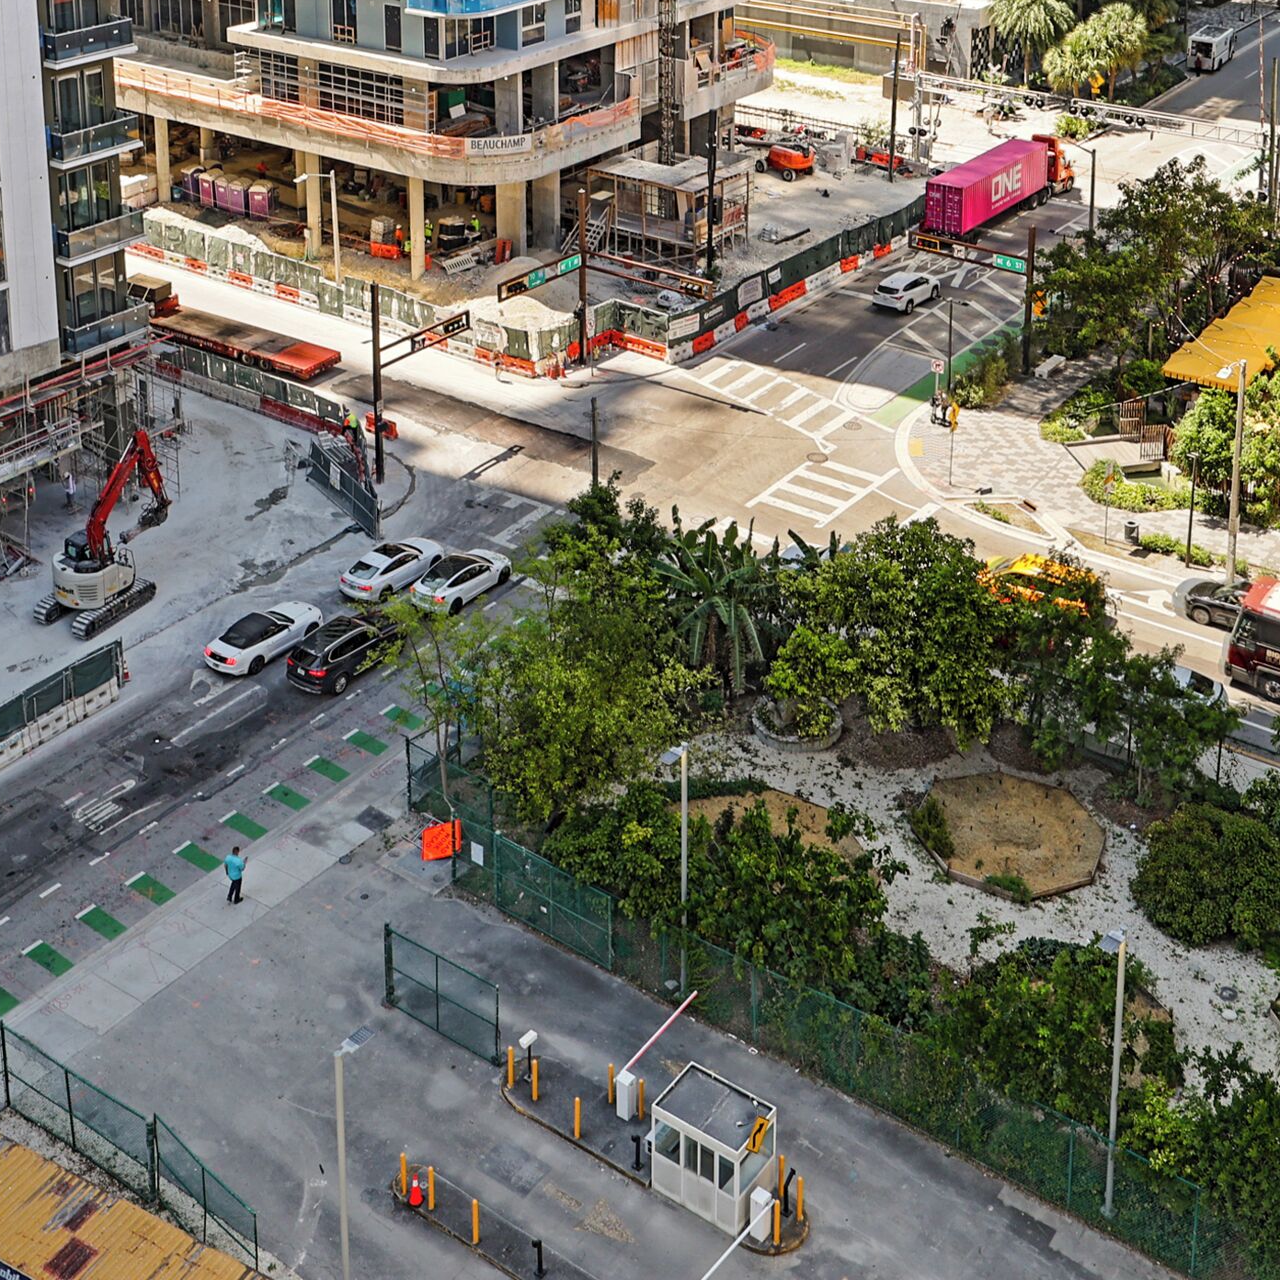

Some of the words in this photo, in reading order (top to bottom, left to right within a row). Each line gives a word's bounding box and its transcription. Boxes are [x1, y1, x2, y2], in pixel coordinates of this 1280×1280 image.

[470, 136, 526, 149] BEAUCHAMP
[991, 163, 1023, 202] ONE
[425, 827, 445, 848] AHEAD
